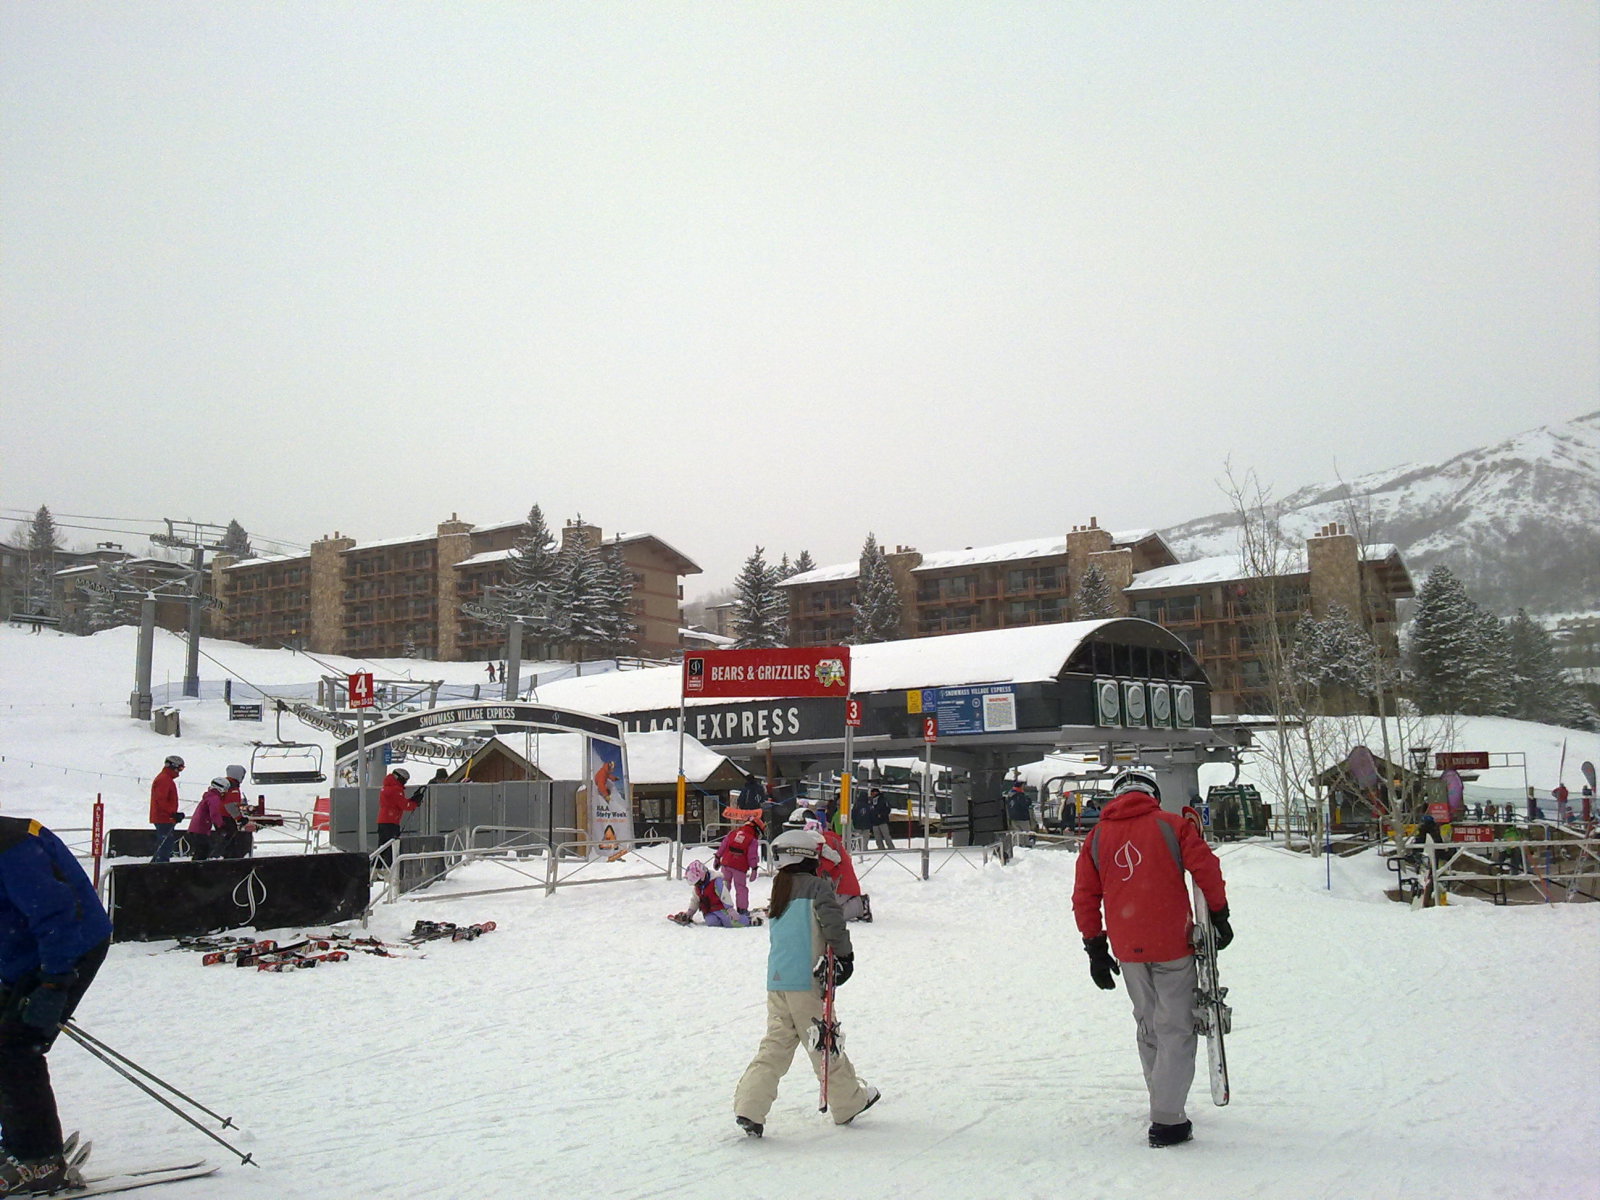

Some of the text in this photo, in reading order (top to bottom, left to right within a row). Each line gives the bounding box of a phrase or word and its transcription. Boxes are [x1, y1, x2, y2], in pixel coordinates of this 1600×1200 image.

[711, 664, 810, 681] BEARS & GRIZZLIES
[355, 675, 368, 697] 4
[419, 707, 516, 728] SNOWMASS VILLAGE EXPRESS
[849, 702, 858, 719] 3
[696, 707, 800, 740] EXPRESS
[926, 720, 934, 736] 2
